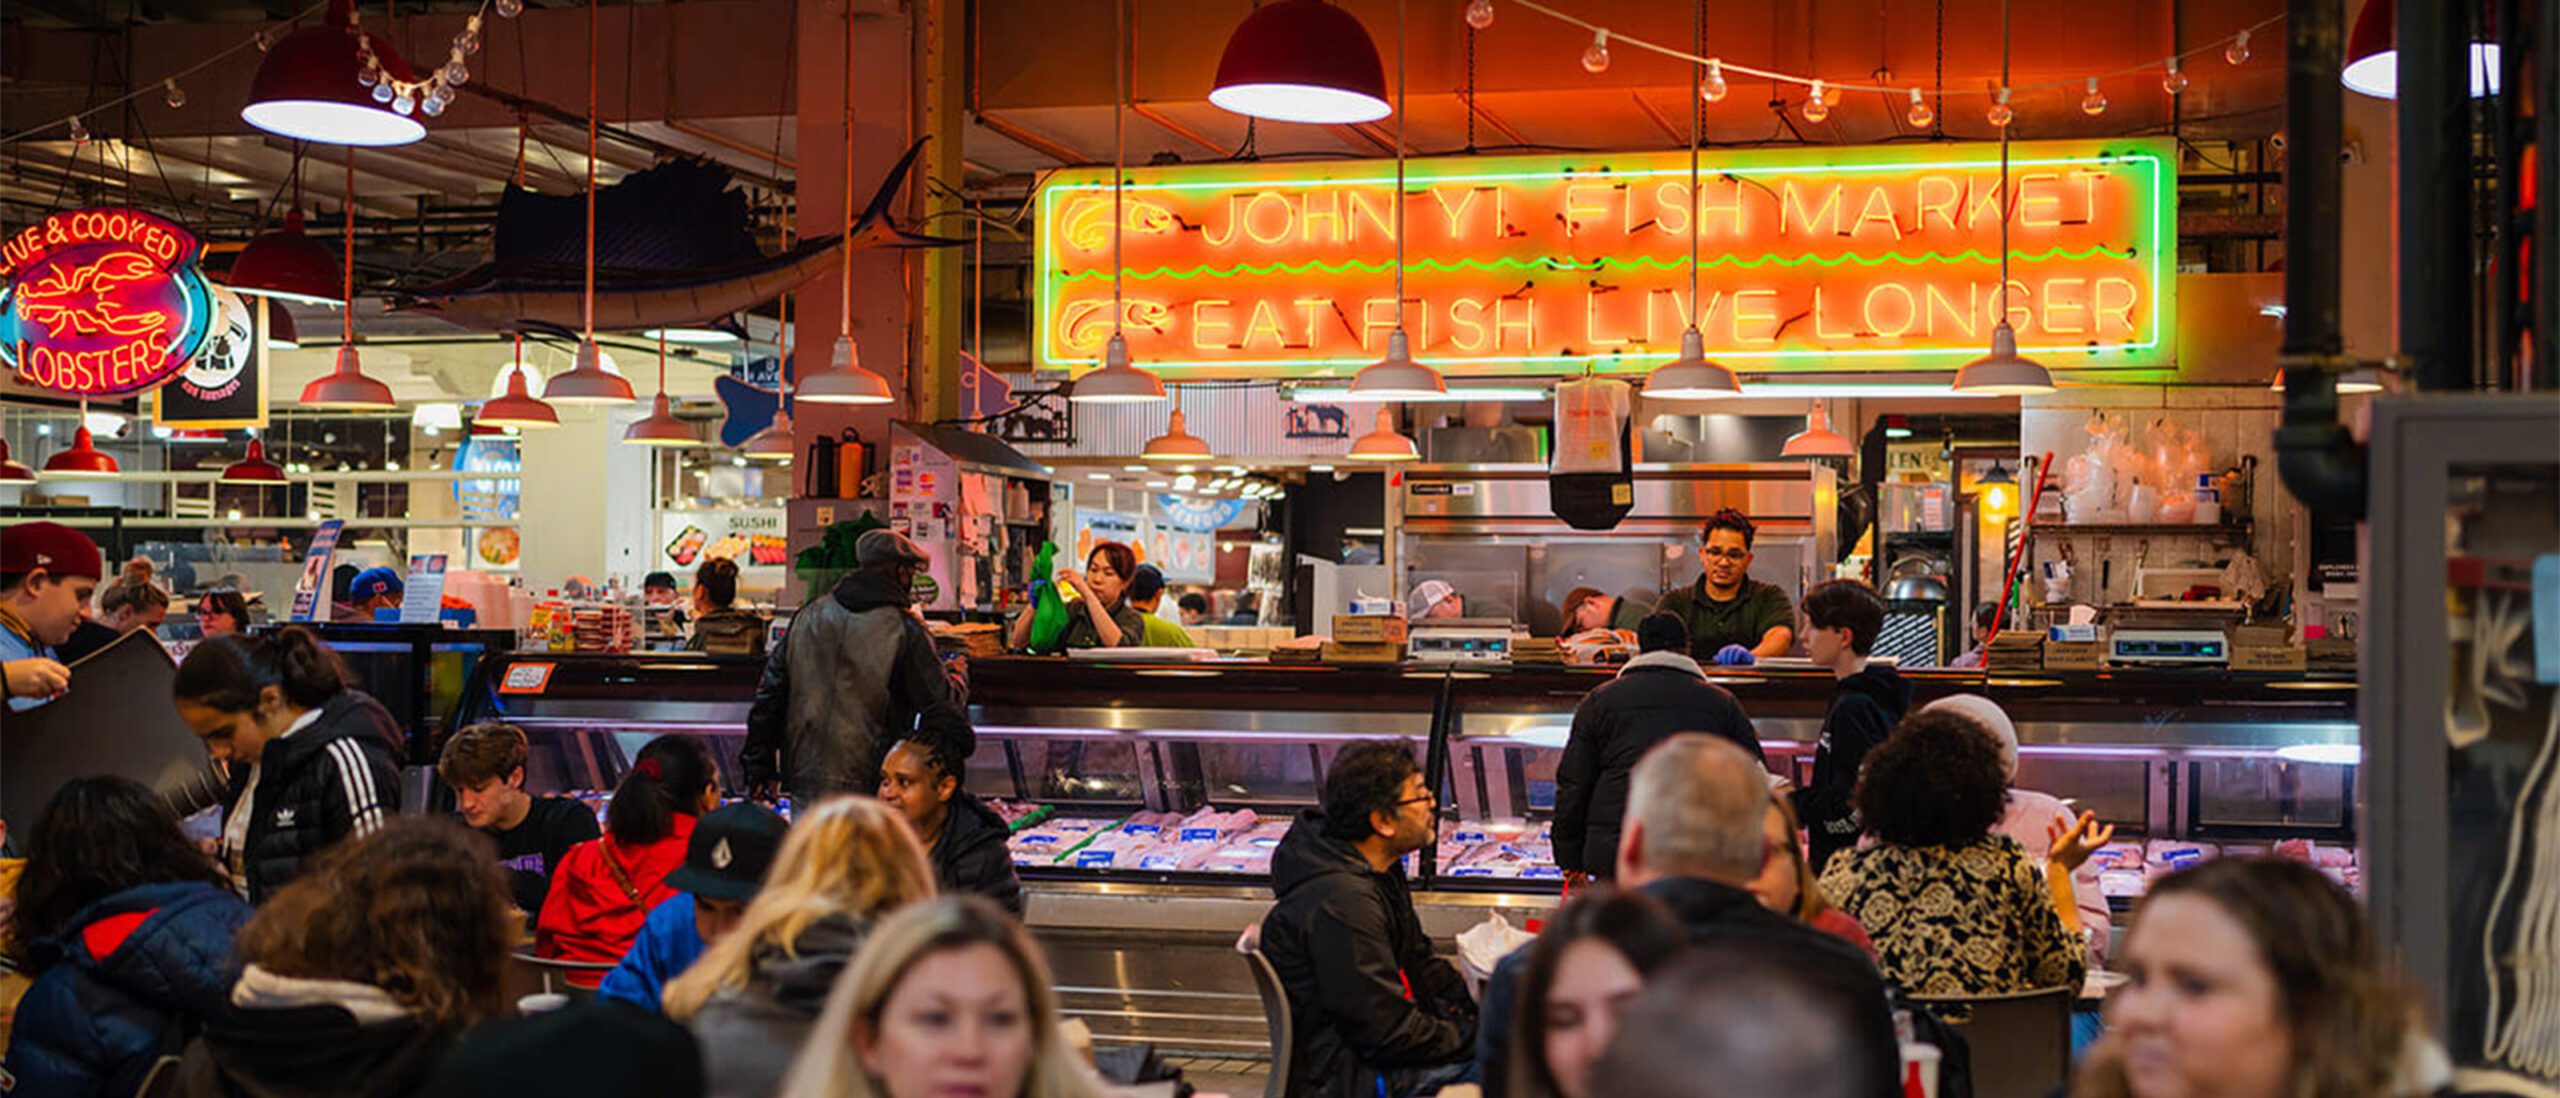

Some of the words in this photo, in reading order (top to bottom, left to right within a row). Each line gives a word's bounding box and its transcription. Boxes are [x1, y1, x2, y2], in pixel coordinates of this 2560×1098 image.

[1201, 191, 1397, 246] JOHN
[1432, 185, 1503, 238] YI
[1565, 181, 1743, 238] FISH
[1781, 170, 2111, 240] MARKET
[46, 217, 69, 244] &
[72, 213, 177, 260] COOKED
[1193, 300, 1333, 349] EAT
[1363, 298, 1534, 351] FISH
[1587, 289, 1777, 345] LIVE
[1814, 277, 2138, 339] LONGER
[17, 328, 168, 389] LOBSTERS
[728, 517, 777, 529] SUSHI
[1167, 501, 1233, 528] SEAFOOD
